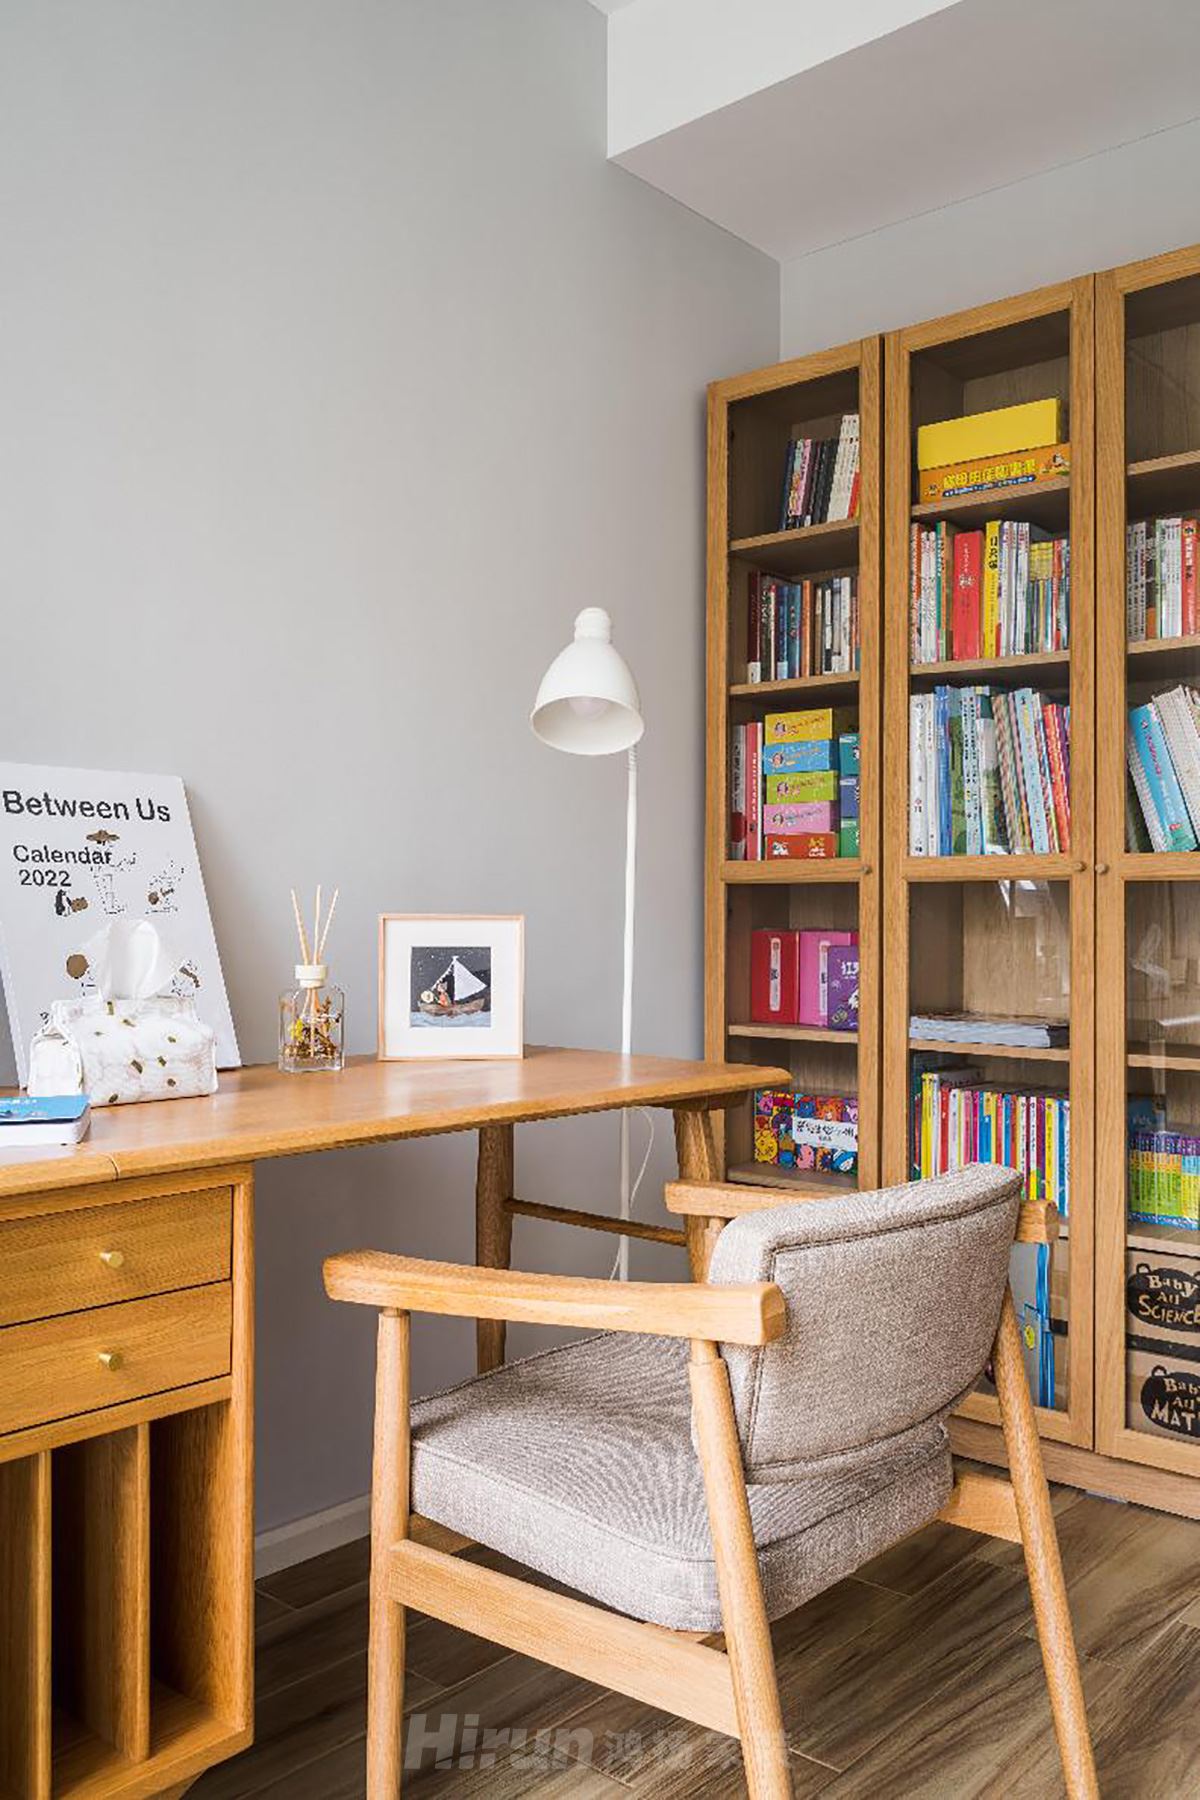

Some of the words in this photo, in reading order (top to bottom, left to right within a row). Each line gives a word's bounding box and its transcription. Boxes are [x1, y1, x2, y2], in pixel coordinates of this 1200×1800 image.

[3, 790, 129, 820] Between
[136, 798, 171, 822] Us
[13, 845, 112, 864] Calendar
[19, 869, 72, 887] 2022
[1147, 1275, 1198, 1298] Baby
[1163, 1377, 1200, 1394] Bab
[1151, 1399, 1200, 1431] MAT
